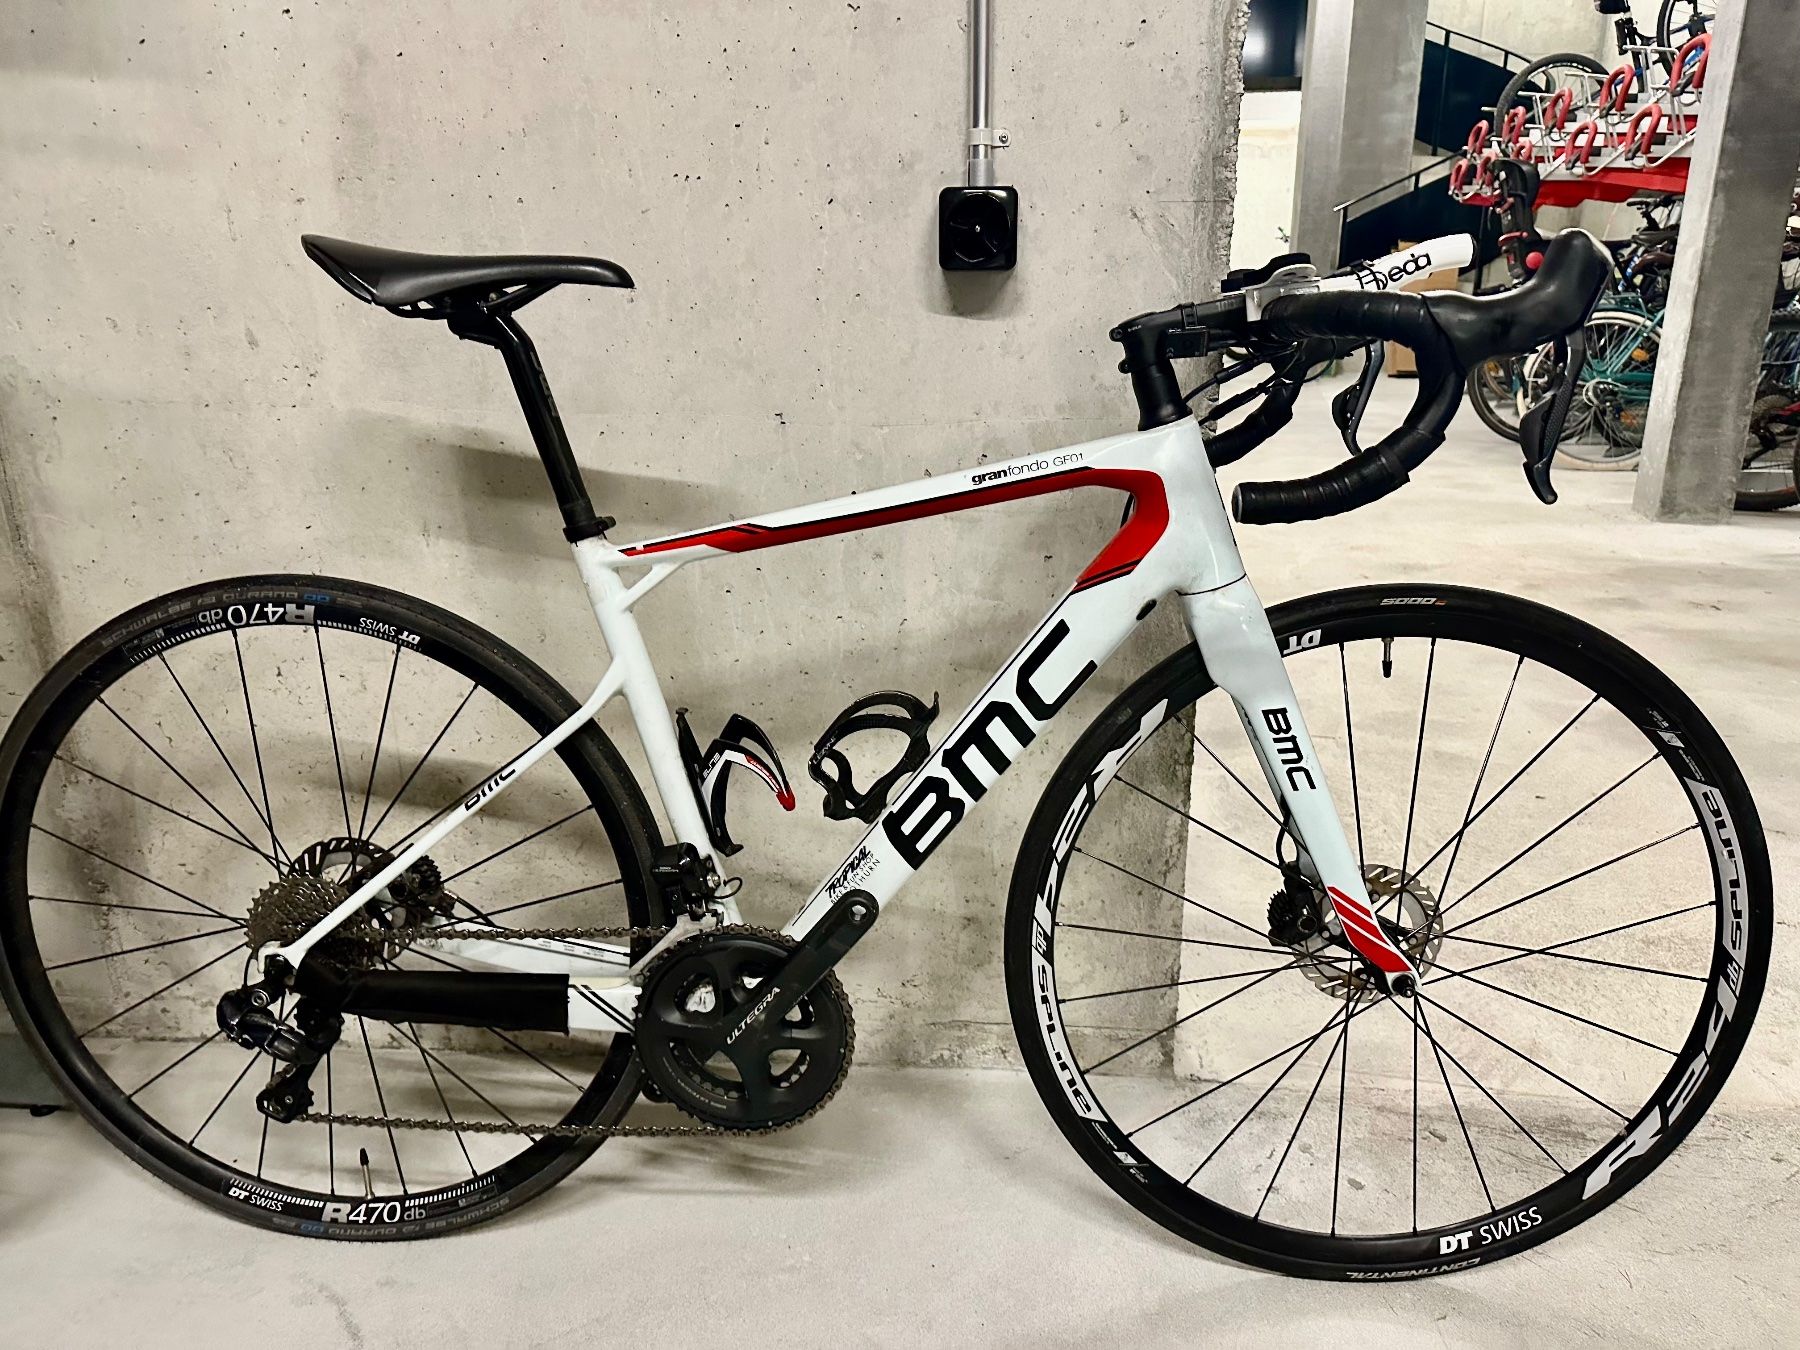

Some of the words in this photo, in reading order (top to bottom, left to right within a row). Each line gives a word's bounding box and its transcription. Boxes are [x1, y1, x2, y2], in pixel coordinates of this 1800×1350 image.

[1052, 452, 1084, 467] GF01
[198, 607, 223, 624] db
[227, 603, 315, 627] R470
[358, 617, 398, 637] SWISS
[400, 630, 421, 646] DT
[1283, 628, 1322, 656] DT
[882, 619, 1098, 870] BMC
[1261, 707, 1317, 792] BMC
[858, 853, 875, 872] SHOP
[726, 986, 781, 1045] ULTEGRA
[228, 1187, 249, 1200] DT
[248, 1195, 284, 1212] SWISS
[320, 1202, 400, 1225] R470
[404, 1206, 426, 1221] db
[1439, 1230, 1473, 1255] DT
[1479, 1206, 1543, 1245] SWISS
[1346, 1257, 1482, 1279] CONTINENTAL
